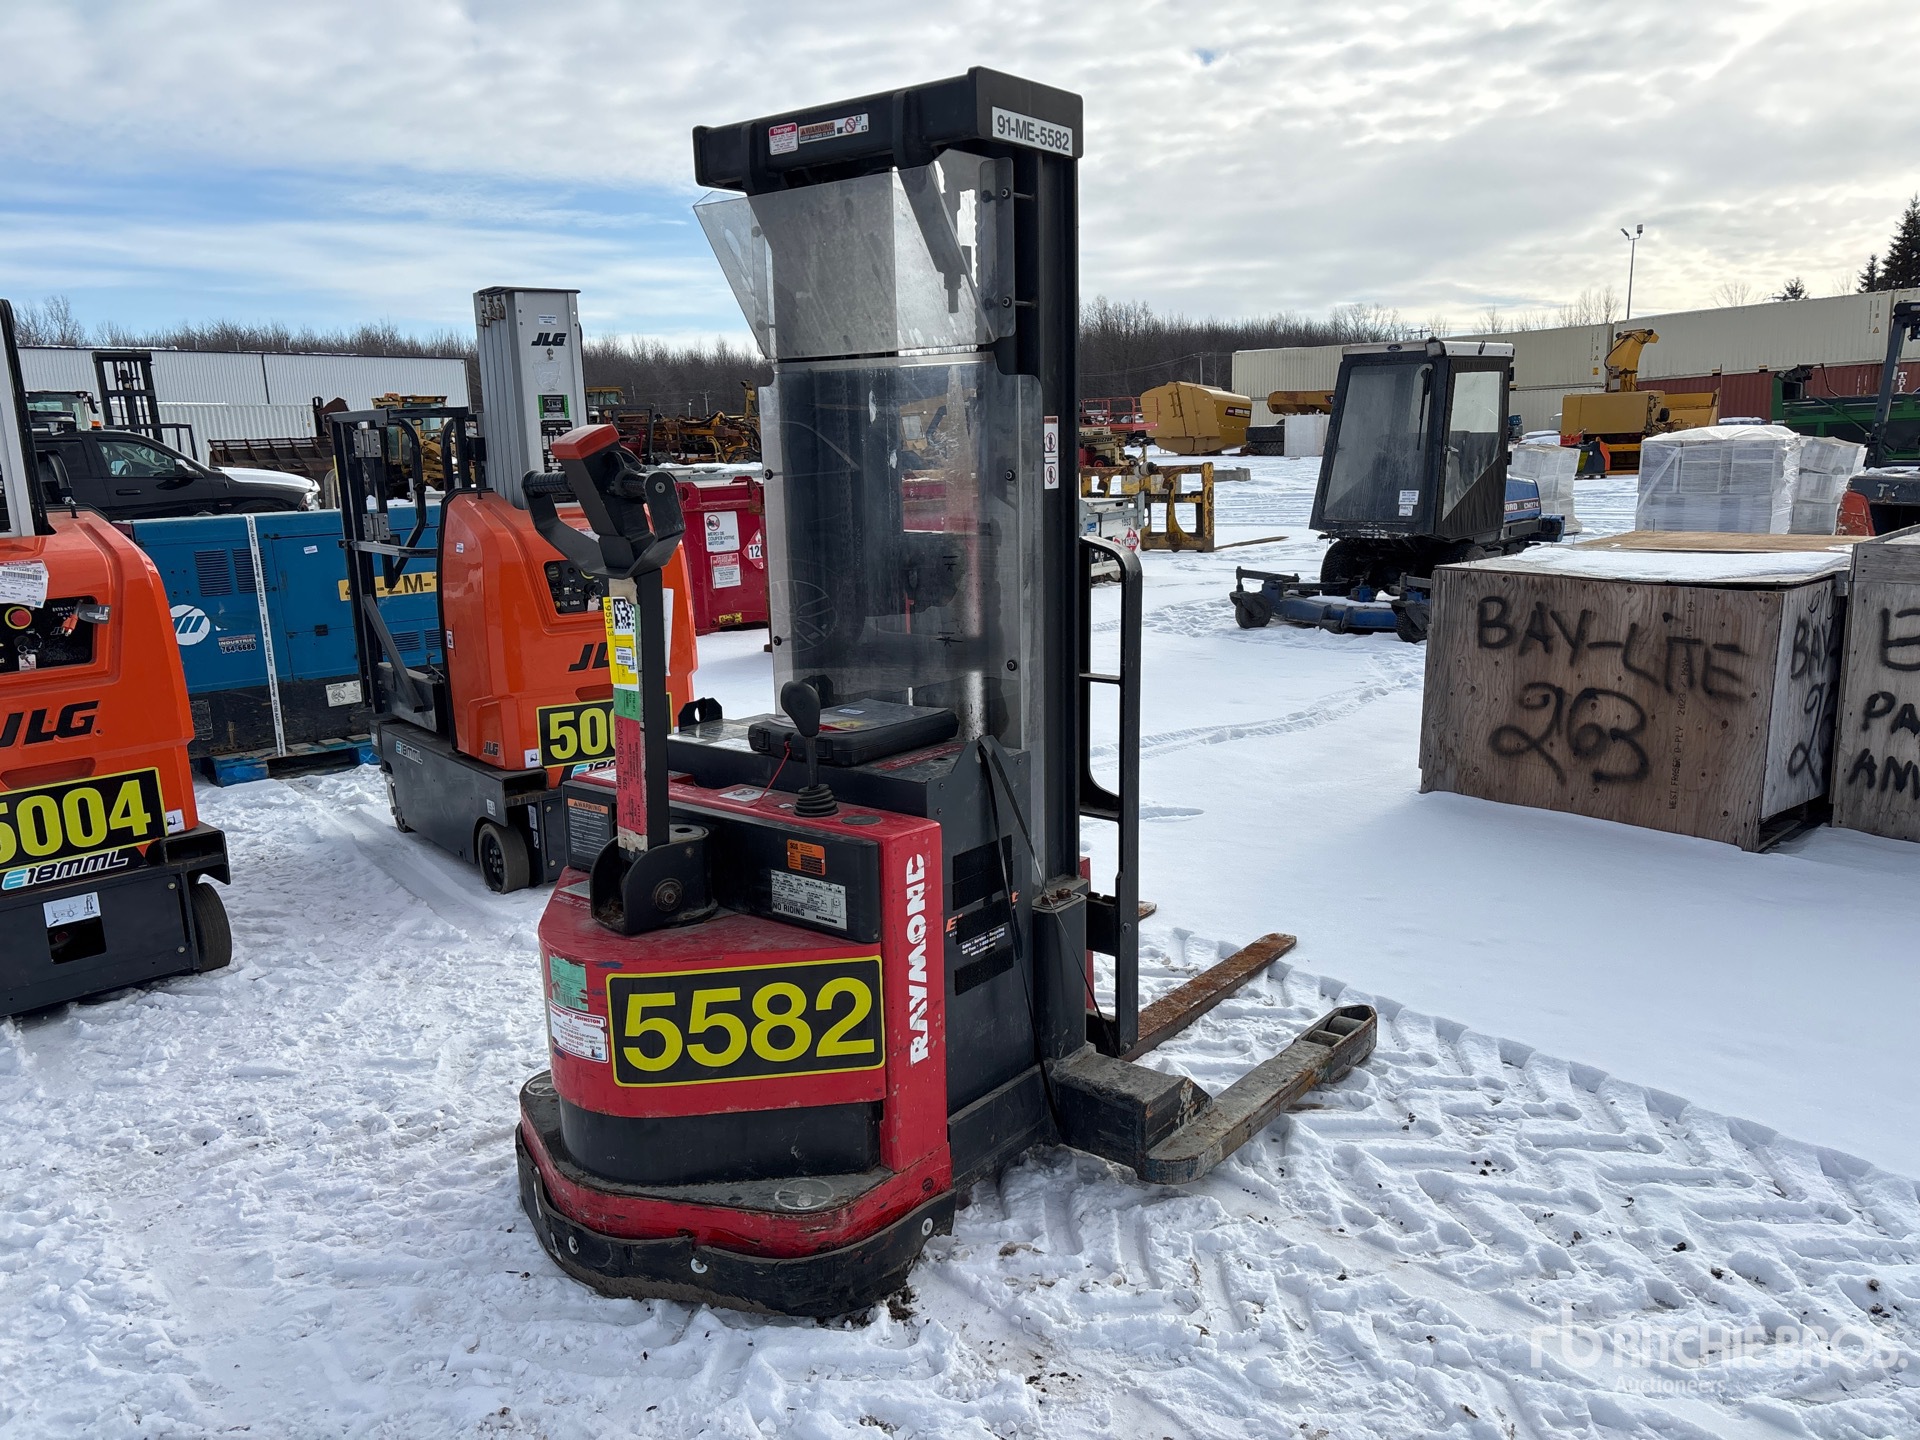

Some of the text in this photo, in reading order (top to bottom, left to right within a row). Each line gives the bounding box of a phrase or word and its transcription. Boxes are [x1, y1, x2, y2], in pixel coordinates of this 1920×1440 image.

[773, 126, 793, 134] Danger
[805, 122, 835, 134] WARNING
[997, 114, 1069, 151] 91-ME-5582
[531, 332, 567, 346] JLG
[604, 599, 614, 637] 195513
[0, 701, 100, 747] JLG
[549, 707, 615, 760] 50
[484, 741, 498, 756] JLG
[616, 719, 624, 766] CARGO
[577, 801, 602, 812] WARNING
[2, 850, 129, 891] E18MML
[772, 902, 805, 917] NO RIDING
[574, 1014, 601, 1025] JOHNSTON
[623, 977, 875, 1072] 5582
